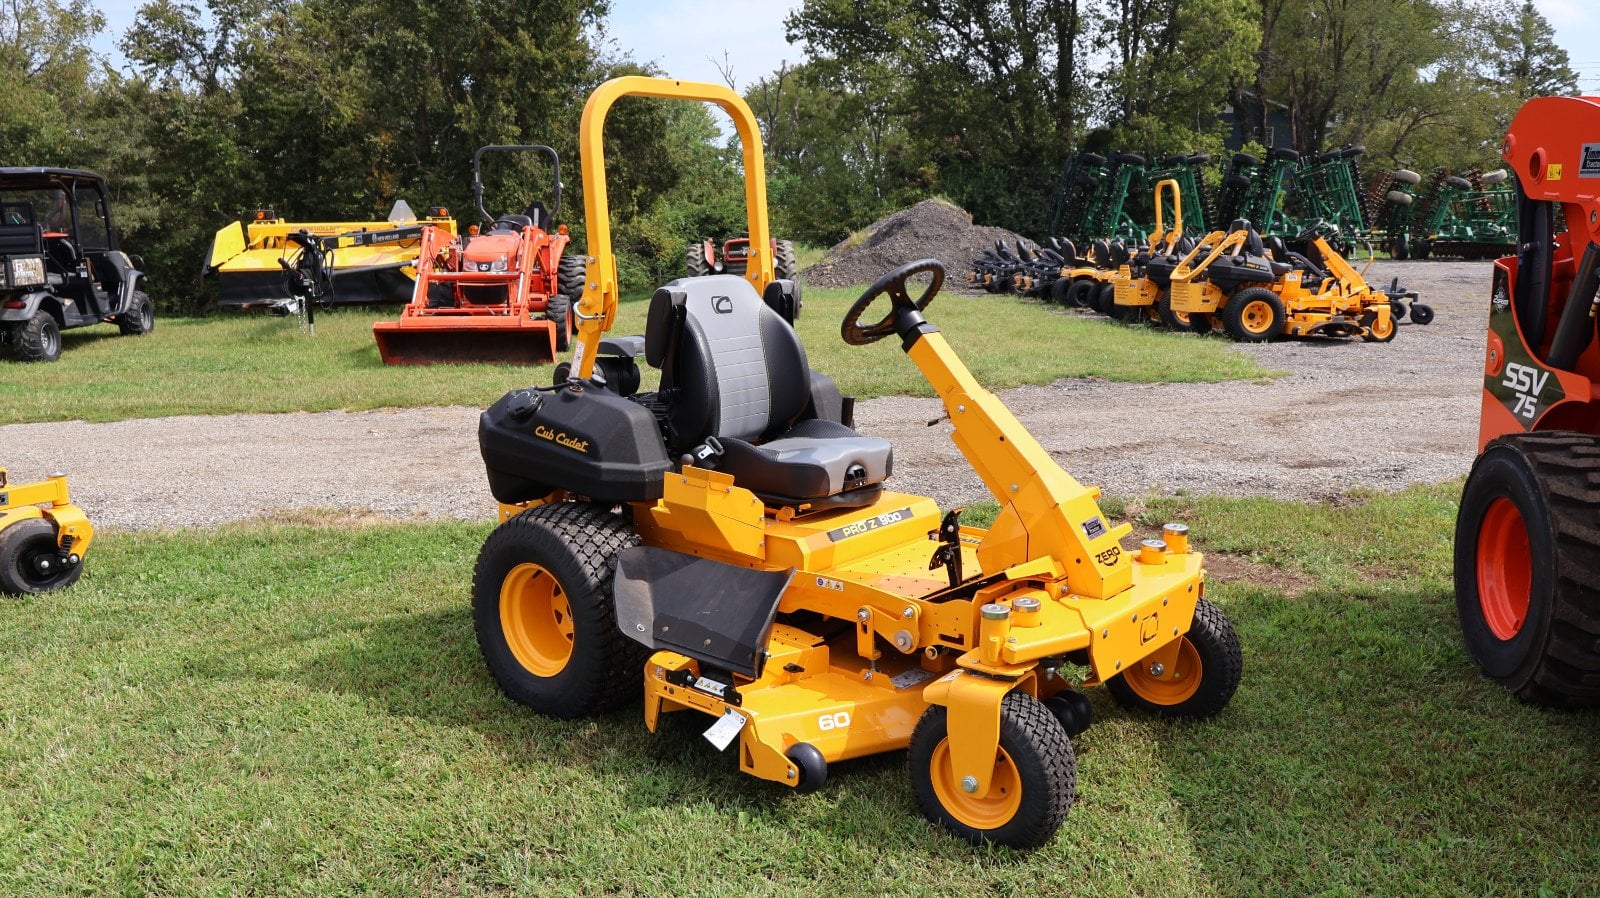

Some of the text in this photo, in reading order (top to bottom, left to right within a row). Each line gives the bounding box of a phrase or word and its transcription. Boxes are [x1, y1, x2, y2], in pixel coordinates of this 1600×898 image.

[1502, 361, 1550, 396] SSV
[1513, 392, 1538, 419] 75
[535, 425, 589, 453] Cub Cadet
[842, 512, 902, 537] PRO Z 900
[1095, 546, 1121, 564] ZERO
[818, 711, 850, 731] 60
